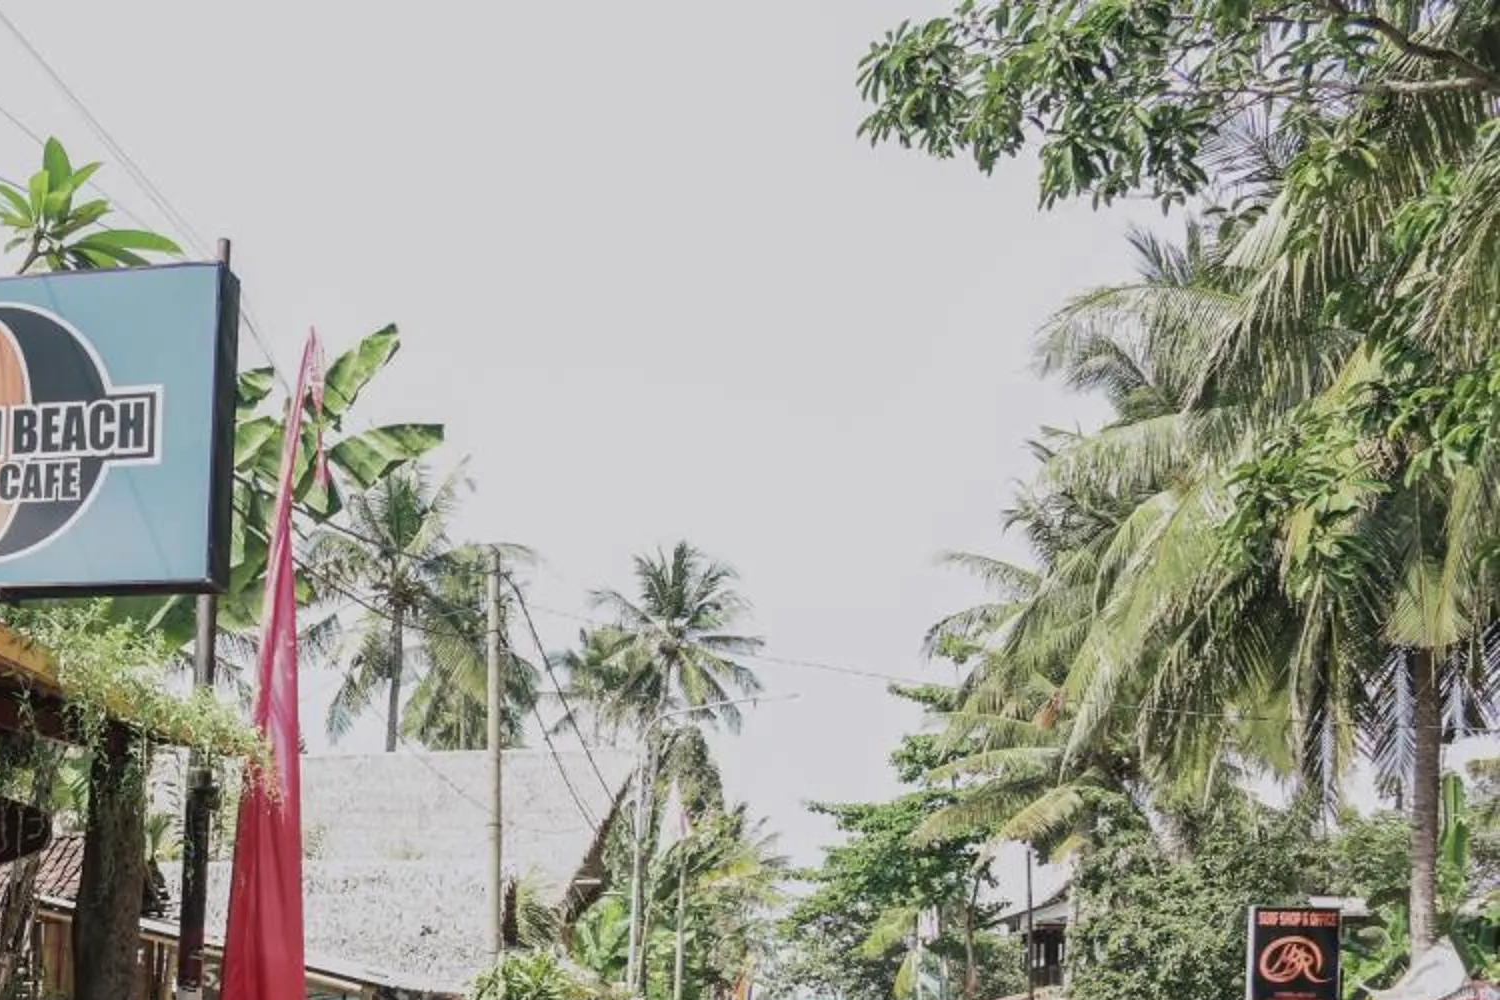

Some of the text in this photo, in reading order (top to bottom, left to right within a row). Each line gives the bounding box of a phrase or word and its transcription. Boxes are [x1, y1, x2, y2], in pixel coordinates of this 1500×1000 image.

[11, 399, 147, 456] BEACH
[0, 461, 79, 500] CAFE
[1280, 911, 1301, 926] SHOP
